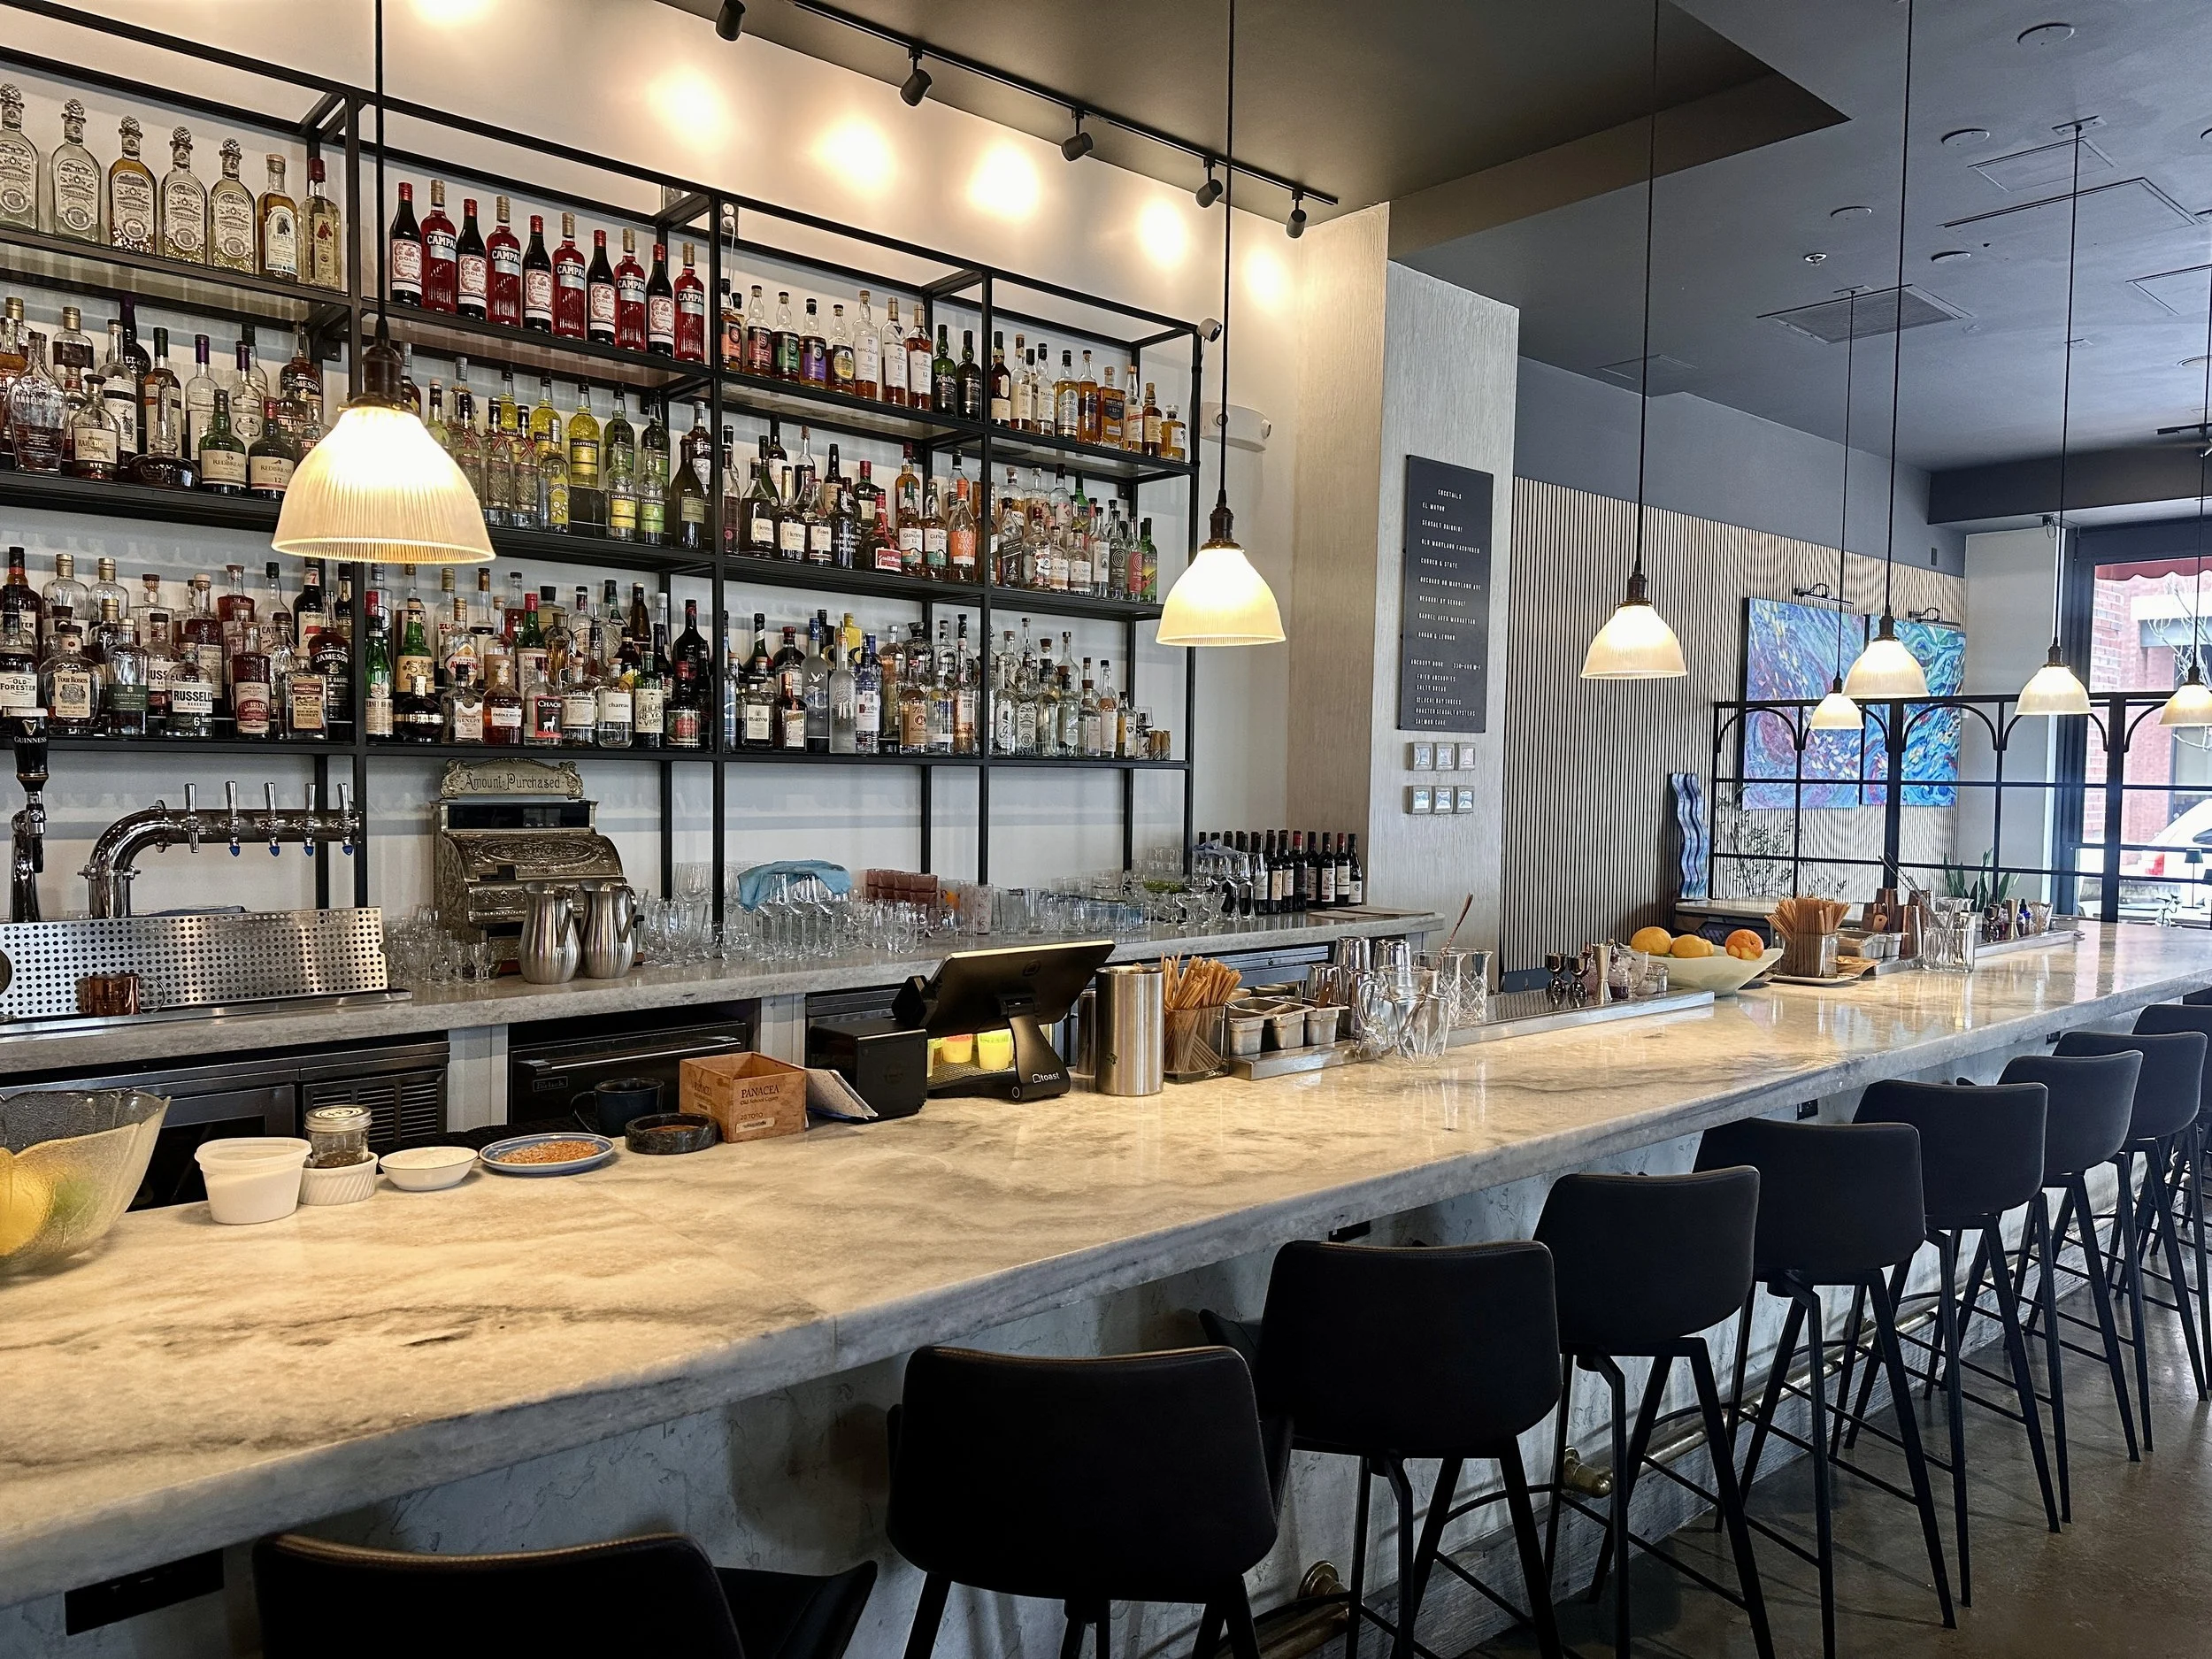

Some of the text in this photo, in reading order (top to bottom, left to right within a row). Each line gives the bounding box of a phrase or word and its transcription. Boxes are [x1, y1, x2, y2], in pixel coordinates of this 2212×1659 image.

[1437, 488, 1462, 500] COCKTAILS
[1422, 518, 1441, 529] SEASALT
[1432, 540, 1455, 550] MARYLAND
[310, 573, 318, 585] 7
[1420, 576, 1440, 585] ORCHARD
[1448, 580, 1471, 589] MARYLAND
[1418, 612, 1435, 621] BARREL
[315, 650, 349, 664] JAMESON
[193, 717, 200, 726] 6
[13, 735, 47, 744] GUINNESS
[460, 769, 560, 791] Amount Purchased
[1041, 1071, 1061, 1081] toast
[741, 1084, 780, 1098] PANACEA
